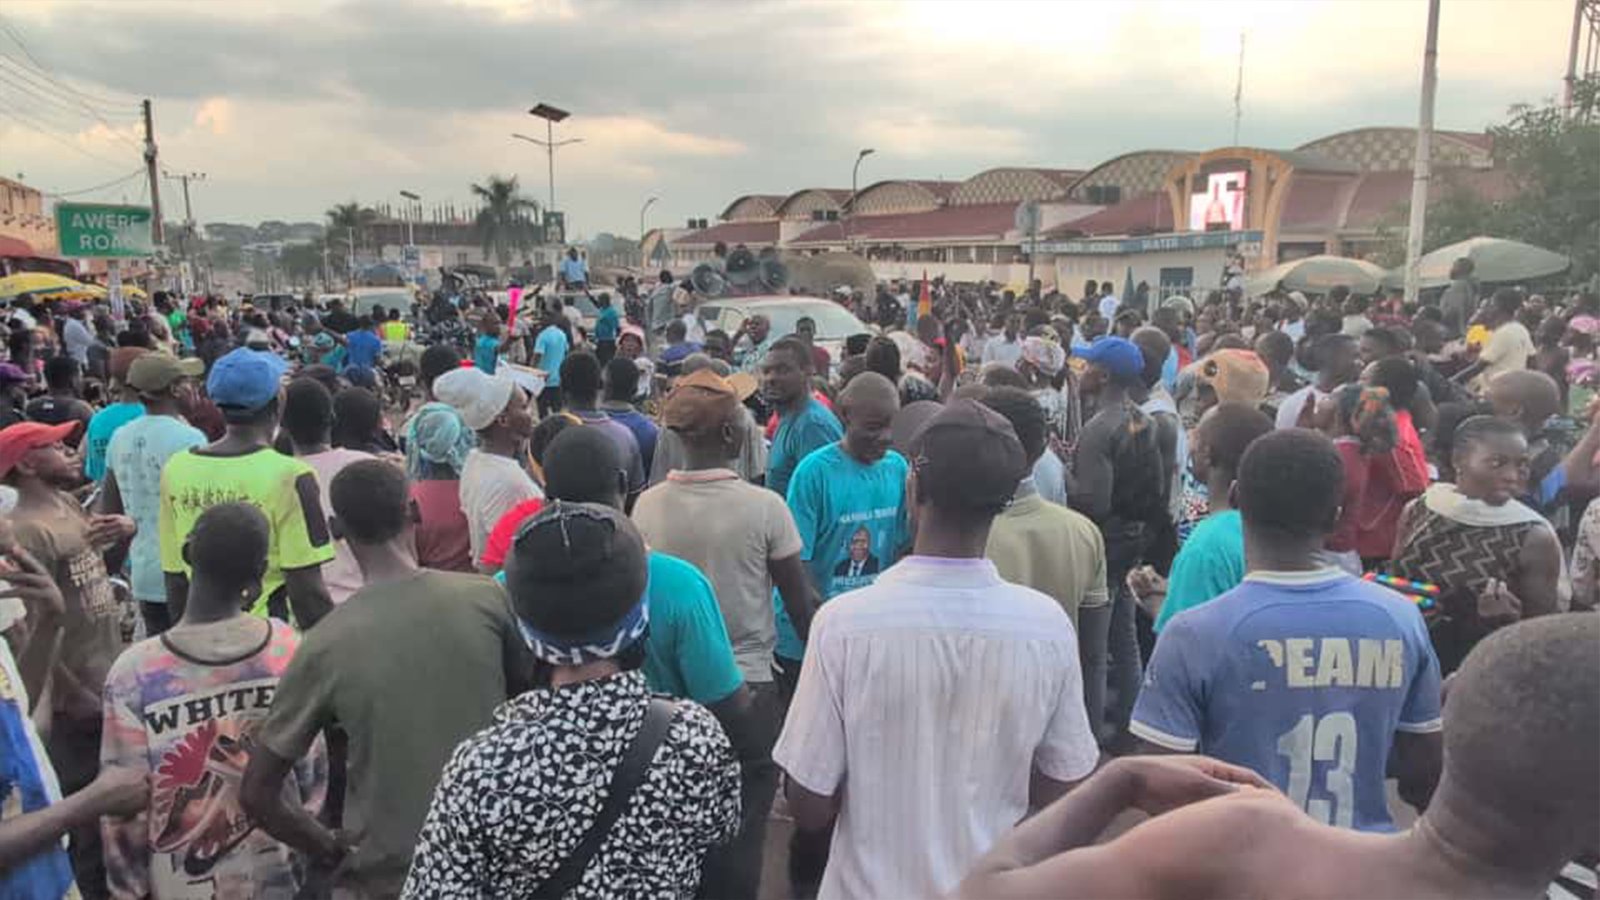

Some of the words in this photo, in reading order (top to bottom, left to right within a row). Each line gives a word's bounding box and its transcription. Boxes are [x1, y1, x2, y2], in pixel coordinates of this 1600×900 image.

[80, 233, 128, 250] ROA
[144, 685, 276, 735] WHITE
[1277, 711, 1358, 828] 13
